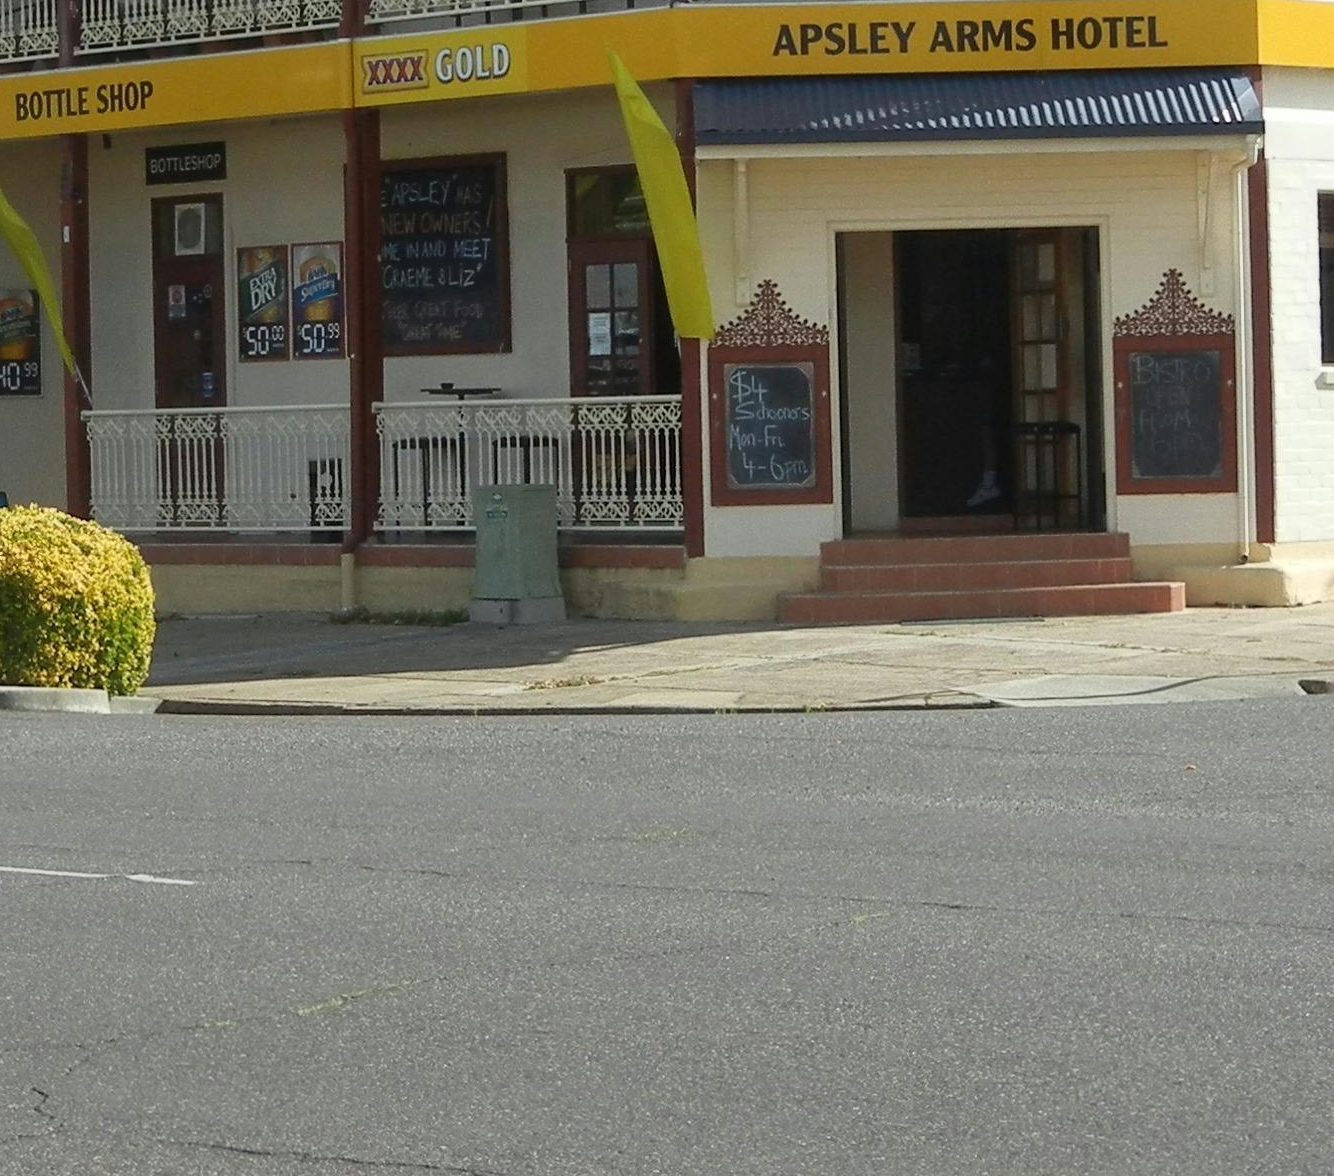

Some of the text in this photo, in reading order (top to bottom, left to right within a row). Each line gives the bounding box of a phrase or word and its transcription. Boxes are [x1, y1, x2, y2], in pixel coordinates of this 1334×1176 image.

[772, 15, 1168, 57] APSLEY ARMS HOTEL
[367, 42, 511, 86] XXXX GOLD
[15, 80, 154, 121] BOTTLE SHOP
[150, 153, 222, 174] BOTTLESHOP
[381, 212, 416, 236] NEW
[454, 237, 492, 261] MEET
[250, 267, 277, 291] EXTRA
[251, 281, 276, 311] DRY
[729, 370, 768, 403] $4
